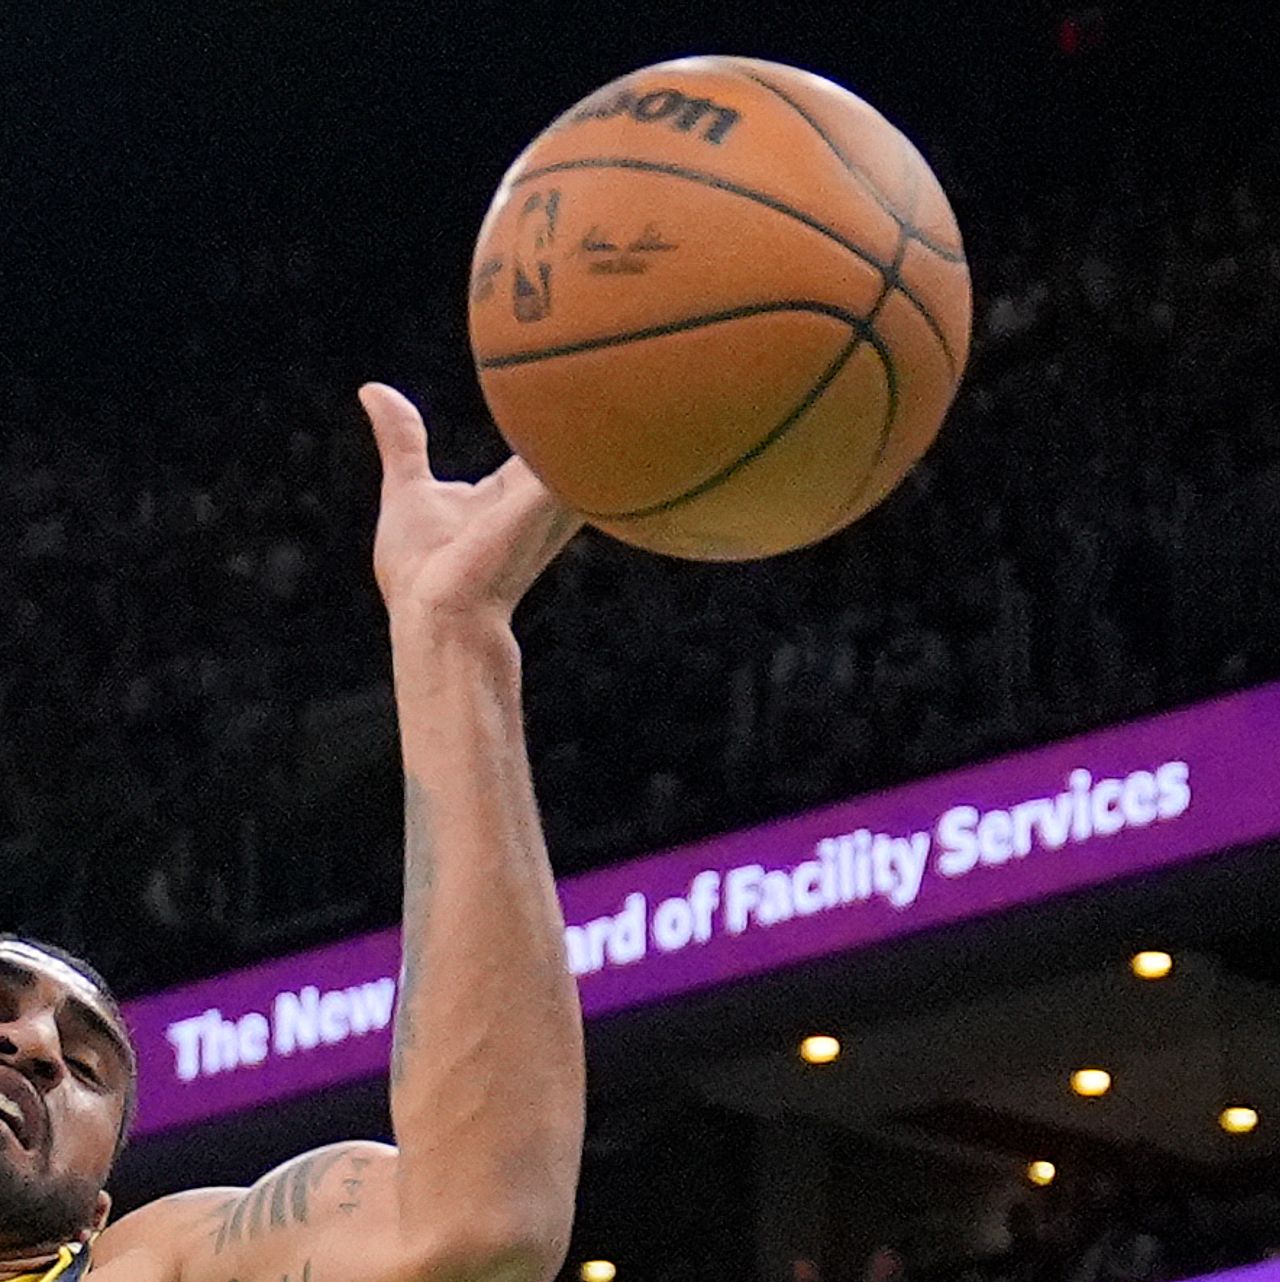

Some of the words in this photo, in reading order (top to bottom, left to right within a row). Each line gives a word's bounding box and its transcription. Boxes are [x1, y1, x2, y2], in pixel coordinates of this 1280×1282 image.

[168, 1009, 269, 1080] The
[274, 977, 395, 1055] New
[565, 893, 646, 975] ard
[652, 871, 720, 951] of
[725, 829, 930, 936] Facility
[936, 760, 1191, 876] Services
